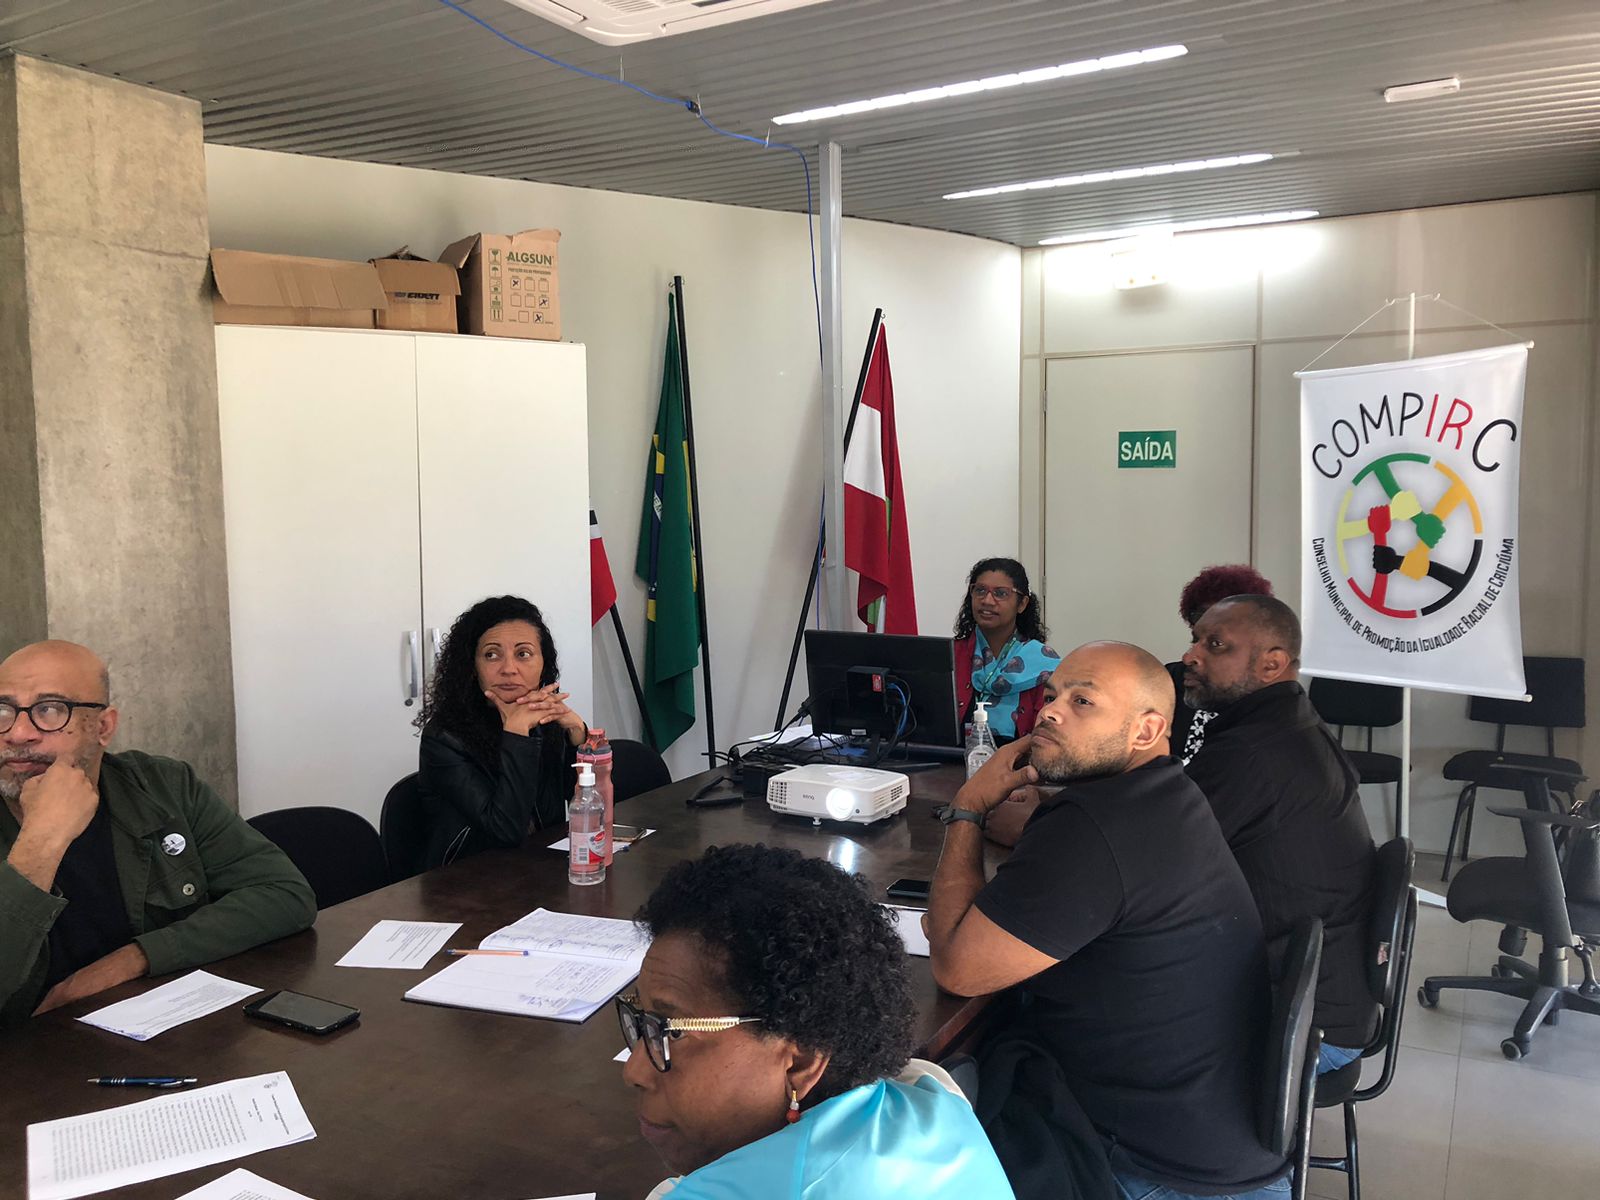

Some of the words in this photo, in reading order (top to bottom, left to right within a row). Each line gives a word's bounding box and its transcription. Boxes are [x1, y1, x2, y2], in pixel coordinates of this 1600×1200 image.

[505, 251, 552, 265] ALGSUN
[1120, 436, 1174, 461] SAÍDA
[1312, 392, 1517, 479] COMPIRC
[1312, 537, 1331, 584] CONSELHO
[1488, 538, 1515, 588] CRICIÚMA
[1325, 581, 1354, 626] MUNICIPAL
[1484, 585, 1500, 601] DE
[1351, 620, 1363, 635] DE
[1460, 599, 1493, 630] RACIAL
[1361, 625, 1406, 653] PROMOÇÃO
[1406, 640, 1419, 653] DA
[1419, 622, 1468, 652] IGUALDADE
